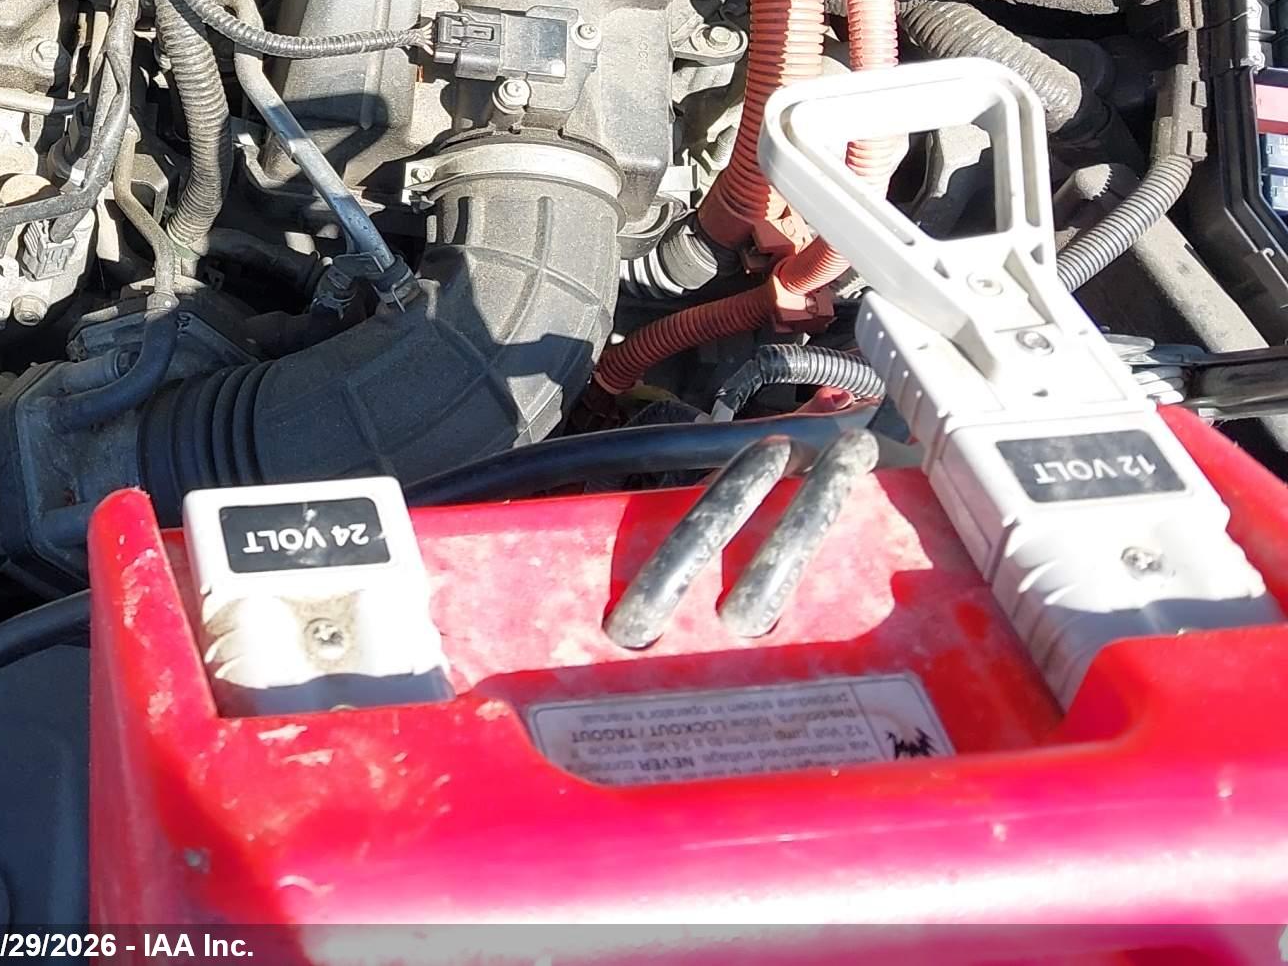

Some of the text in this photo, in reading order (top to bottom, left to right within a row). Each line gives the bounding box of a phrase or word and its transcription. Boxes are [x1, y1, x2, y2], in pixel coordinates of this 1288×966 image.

[1033, 454, 1157, 485] 12 VOLT
[242, 522, 370, 554] 24 VOLT
[571, 727, 636, 742] TAGOUT
[648, 720, 727, 738] LOCKOUT
[638, 756, 696, 772] NEVER
